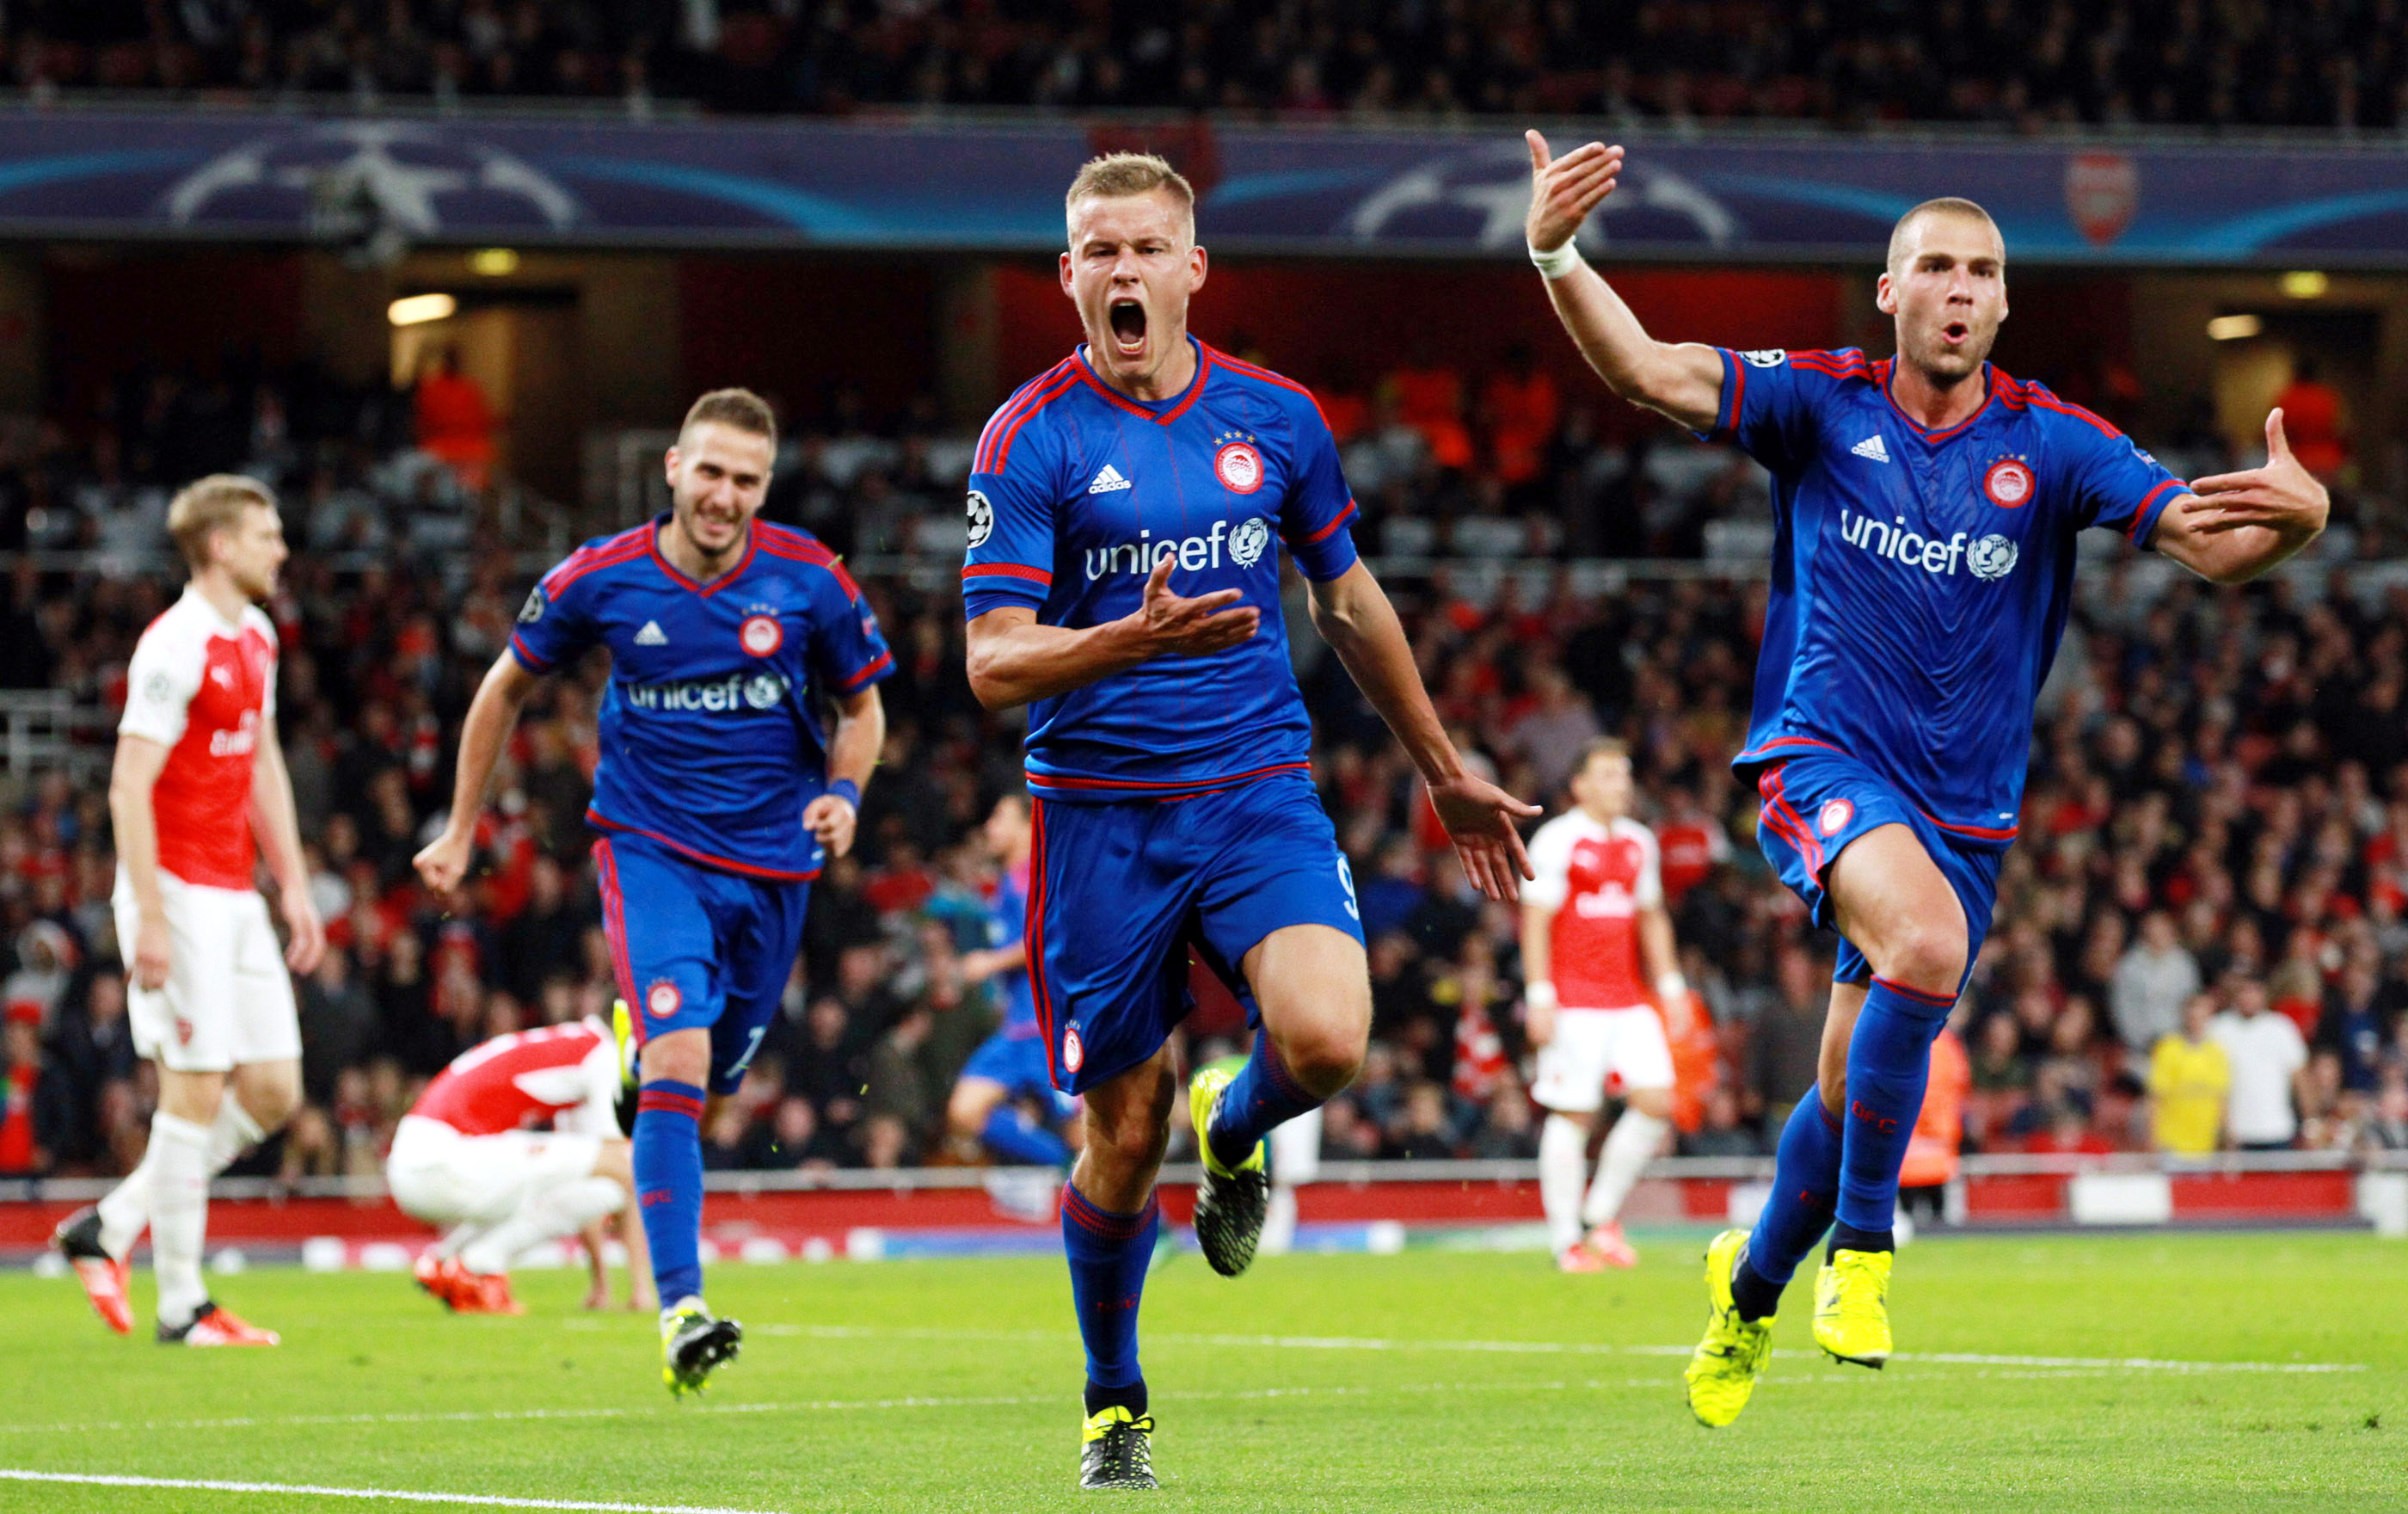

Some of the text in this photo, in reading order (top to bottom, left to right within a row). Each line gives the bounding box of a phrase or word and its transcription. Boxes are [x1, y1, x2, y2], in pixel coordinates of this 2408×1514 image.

[1851, 446, 1890, 464] adidas
[1089, 480, 1132, 495] adidas
[1085, 520, 1227, 581] unicef
[1840, 509, 1967, 575] unicef
[628, 674, 741, 711] unicef
